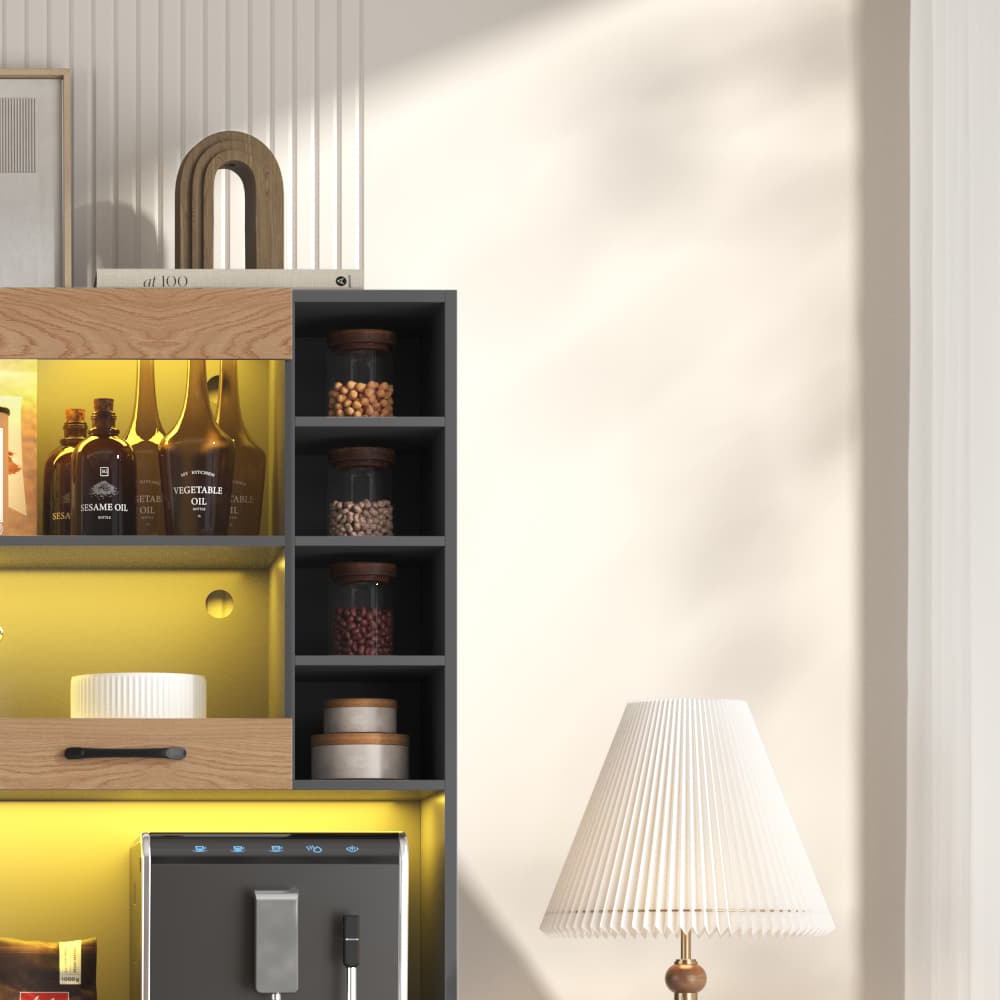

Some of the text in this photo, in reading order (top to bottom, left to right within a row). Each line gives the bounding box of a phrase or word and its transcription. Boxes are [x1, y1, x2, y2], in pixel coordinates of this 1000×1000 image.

[173, 486, 223, 495] VEGETABLE
[191, 497, 207, 506] OIL
[80, 503, 128, 512] SESAME OIL
[52, 512, 71, 521] SESA
